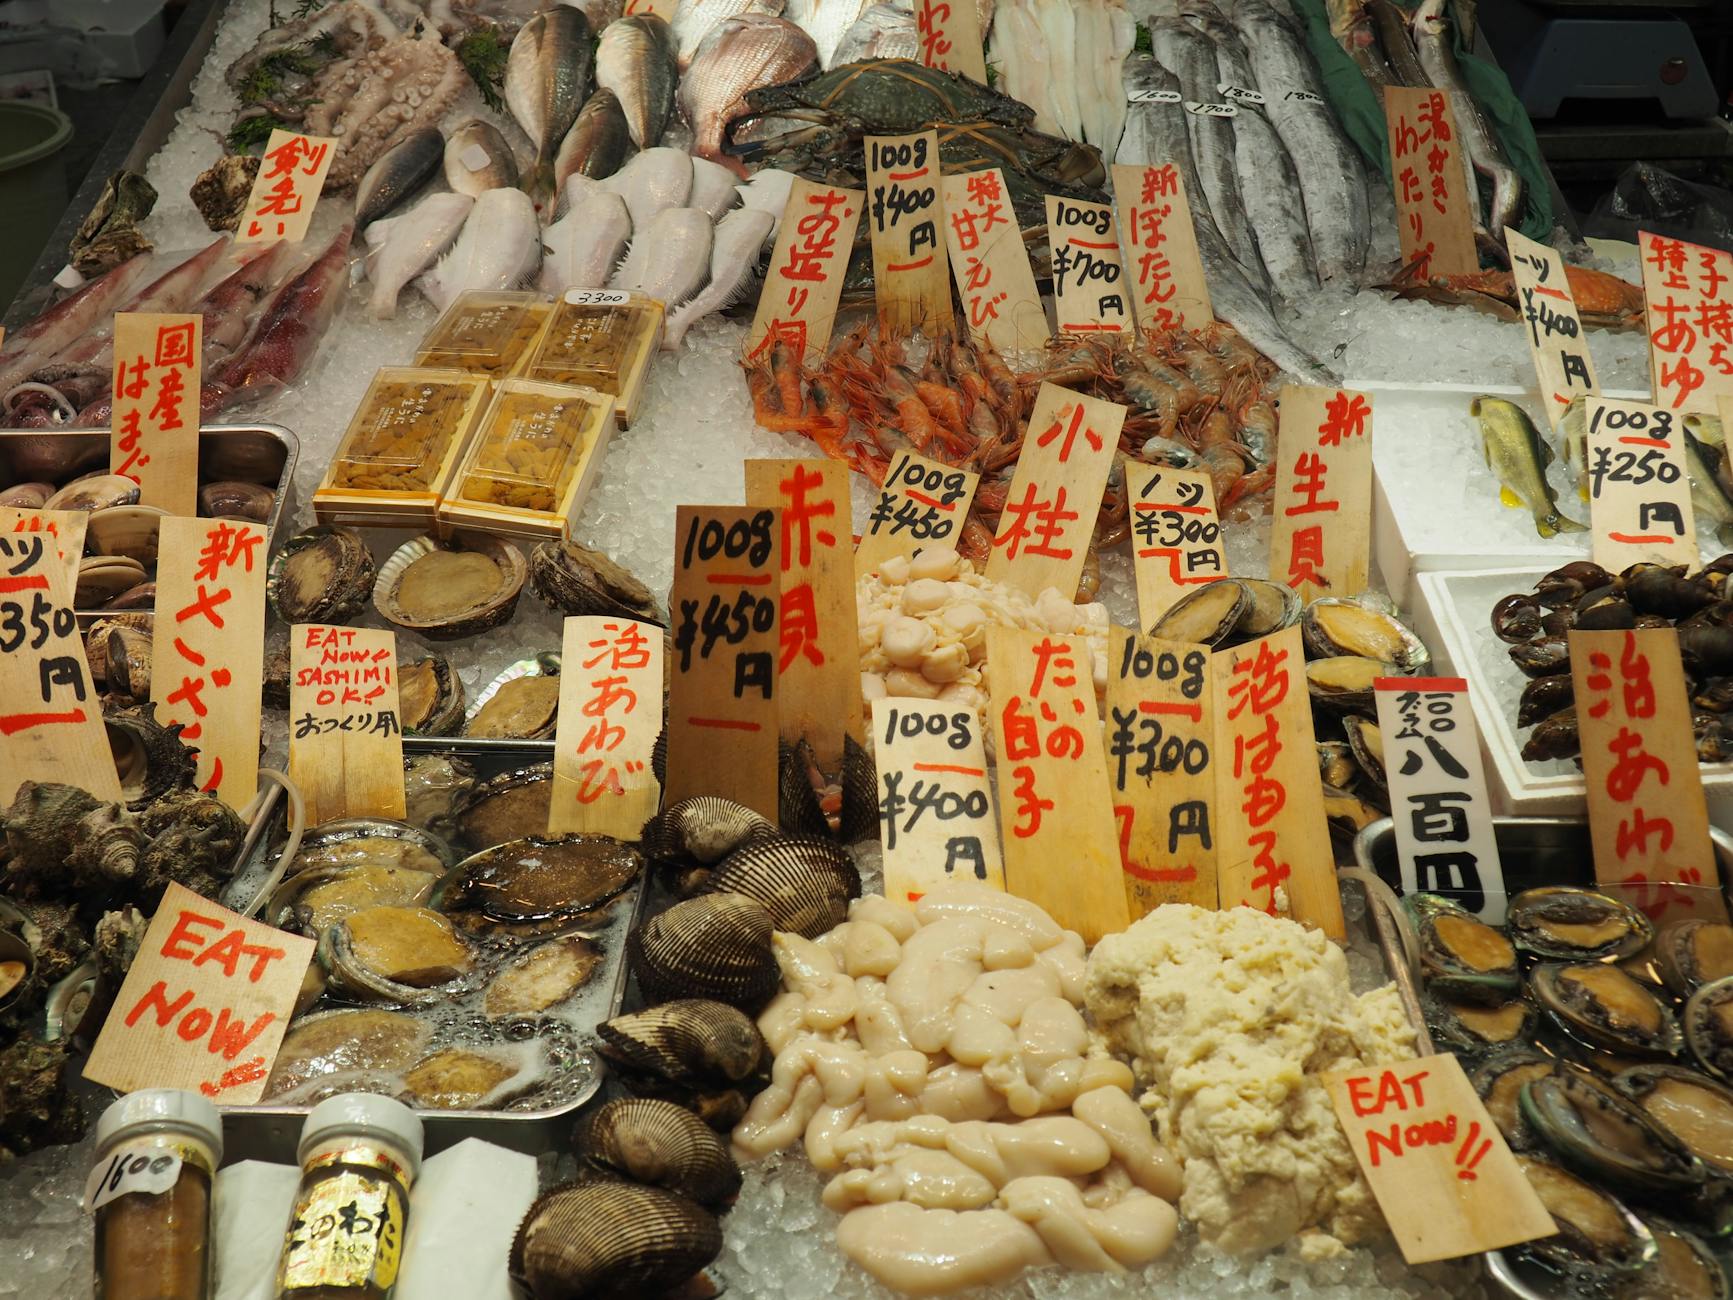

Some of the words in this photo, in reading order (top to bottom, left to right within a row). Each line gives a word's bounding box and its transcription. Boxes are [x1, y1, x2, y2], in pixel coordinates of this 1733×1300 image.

[919, 0, 952, 73] わた
[1134, 90, 1178, 100] 1600
[1194, 104, 1234, 113] 1700
[1224, 86, 1262, 99] 1800
[872, 138, 927, 172] 100g
[873, 183, 935, 232] ¥400
[1056, 202, 1111, 235] 100g
[909, 220, 937, 256] 円
[951, 208, 1008, 328] 甘えび
[1053, 244, 1120, 297] ¥700
[578, 292, 623, 303] 3300
[1098, 294, 1123, 318] 円
[149, 322, 195, 431] 国産
[1560, 350, 1592, 389] 円
[1590, 405, 1673, 441] 100g
[885, 454, 967, 506] 100g
[991, 402, 1104, 561] 小柱
[1589, 446, 1681, 499] ¥250
[682, 509, 775, 569] 100g
[869, 492, 954, 540] ¥450
[1134, 509, 1220, 546] ¥300
[1639, 502, 1686, 536] 円
[778, 463, 837, 676] 赤貝
[1187, 549, 1221, 572] 円
[306, 628, 356, 649] EAT
[675, 590, 776, 673] ¥450
[39, 656, 87, 703] 円
[295, 666, 390, 687] SASHIMI
[734, 652, 773, 700] 円
[1120, 634, 1207, 699] 100g
[575, 622, 652, 805] 活あわび
[1030, 636, 1085, 760] たいの
[885, 708, 972, 750] 100g
[1110, 705, 1210, 791] ¥300
[1001, 694, 1055, 838] 白子
[878, 770, 989, 850] ¥400
[1168, 800, 1213, 854] 円
[944, 836, 987, 880] 円
[159, 910, 286, 983] EAT
[1345, 1070, 1430, 1118] EAT
[91, 1153, 174, 1204] 1600
